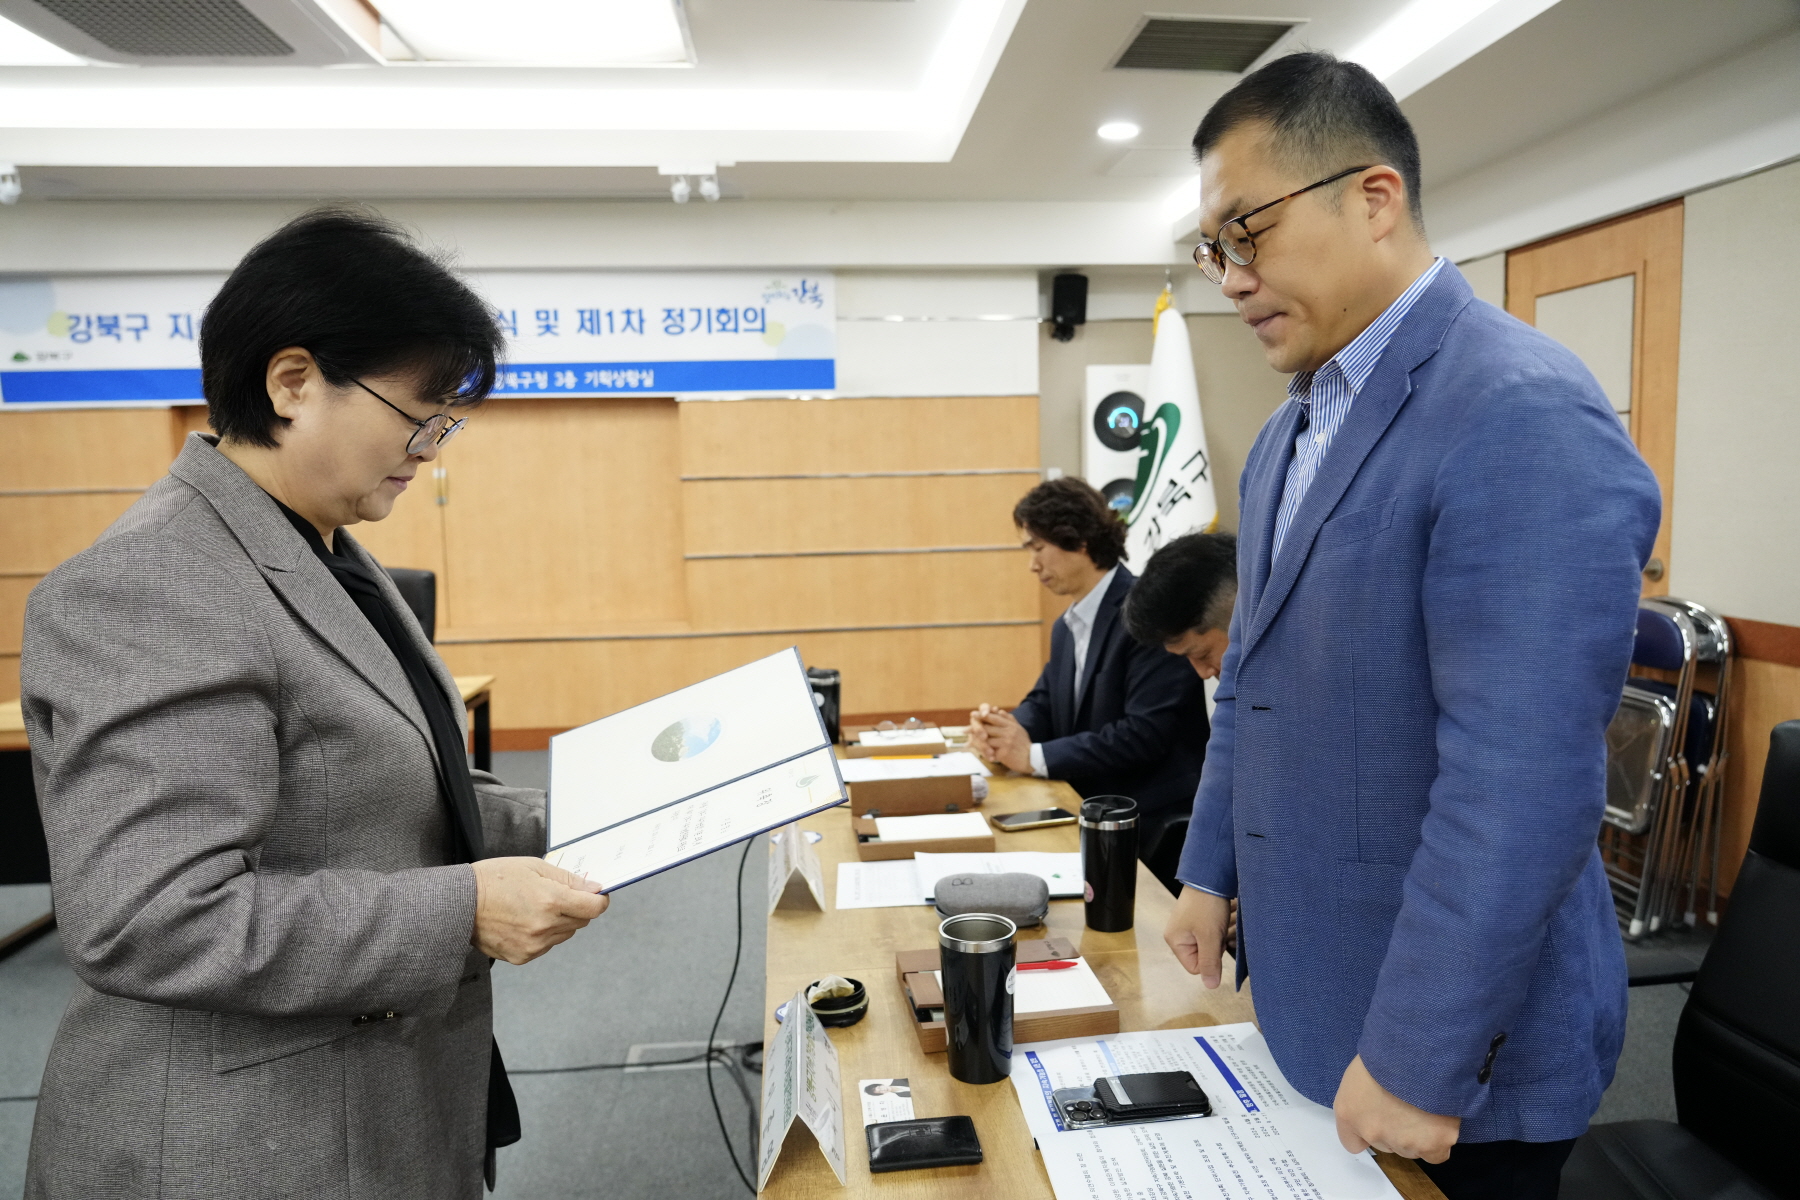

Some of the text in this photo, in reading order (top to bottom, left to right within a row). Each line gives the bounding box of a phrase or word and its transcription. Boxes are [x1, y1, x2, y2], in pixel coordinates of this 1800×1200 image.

[67, 313, 150, 344] 강북구
[534, 308, 560, 337] 및
[576, 307, 645, 336] 제1차
[661, 305, 767, 335] 정기회의
